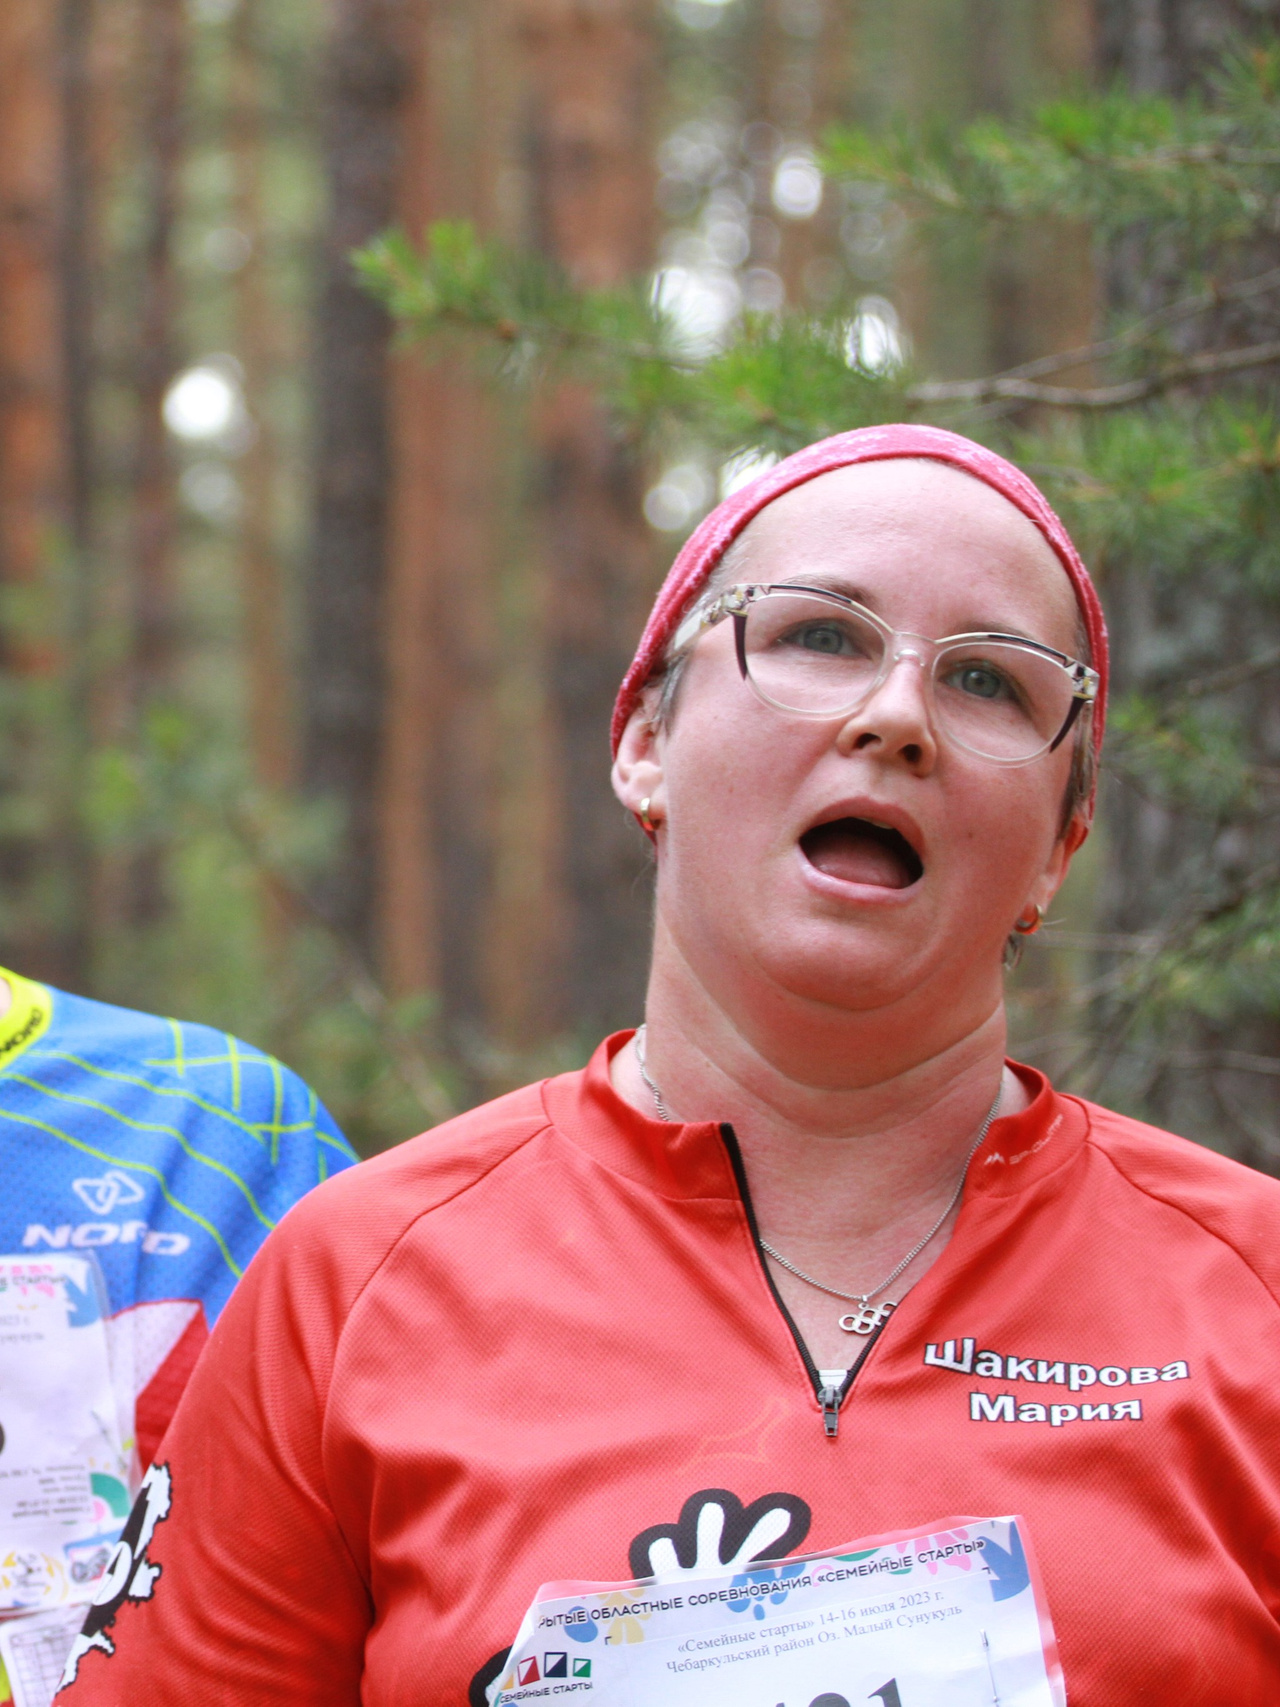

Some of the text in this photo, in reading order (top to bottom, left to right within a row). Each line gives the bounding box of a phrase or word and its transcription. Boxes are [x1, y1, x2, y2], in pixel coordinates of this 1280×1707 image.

[923, 1337, 1190, 1392] Шакирова
[969, 1391, 1143, 1427] Мария
[590, 1596, 684, 1620] ОБЛАСТНЫЕ
[688, 1575, 812, 1606] СОРЕВНОВАНИЯ
[817, 1555, 913, 1583] «СЕМЕЙНЫЕ
[917, 1540, 985, 1564] СТАРТЫ»
[666, 1604, 963, 1674] Чебаркульский район Оз. Малый Сунукуль
[677, 1590, 944, 1653] «Семейные старты» 14-16 июля 2023 г.
[499, 1680, 594, 1704] СЕМЕЙНЫЕ СТАРТЫ
